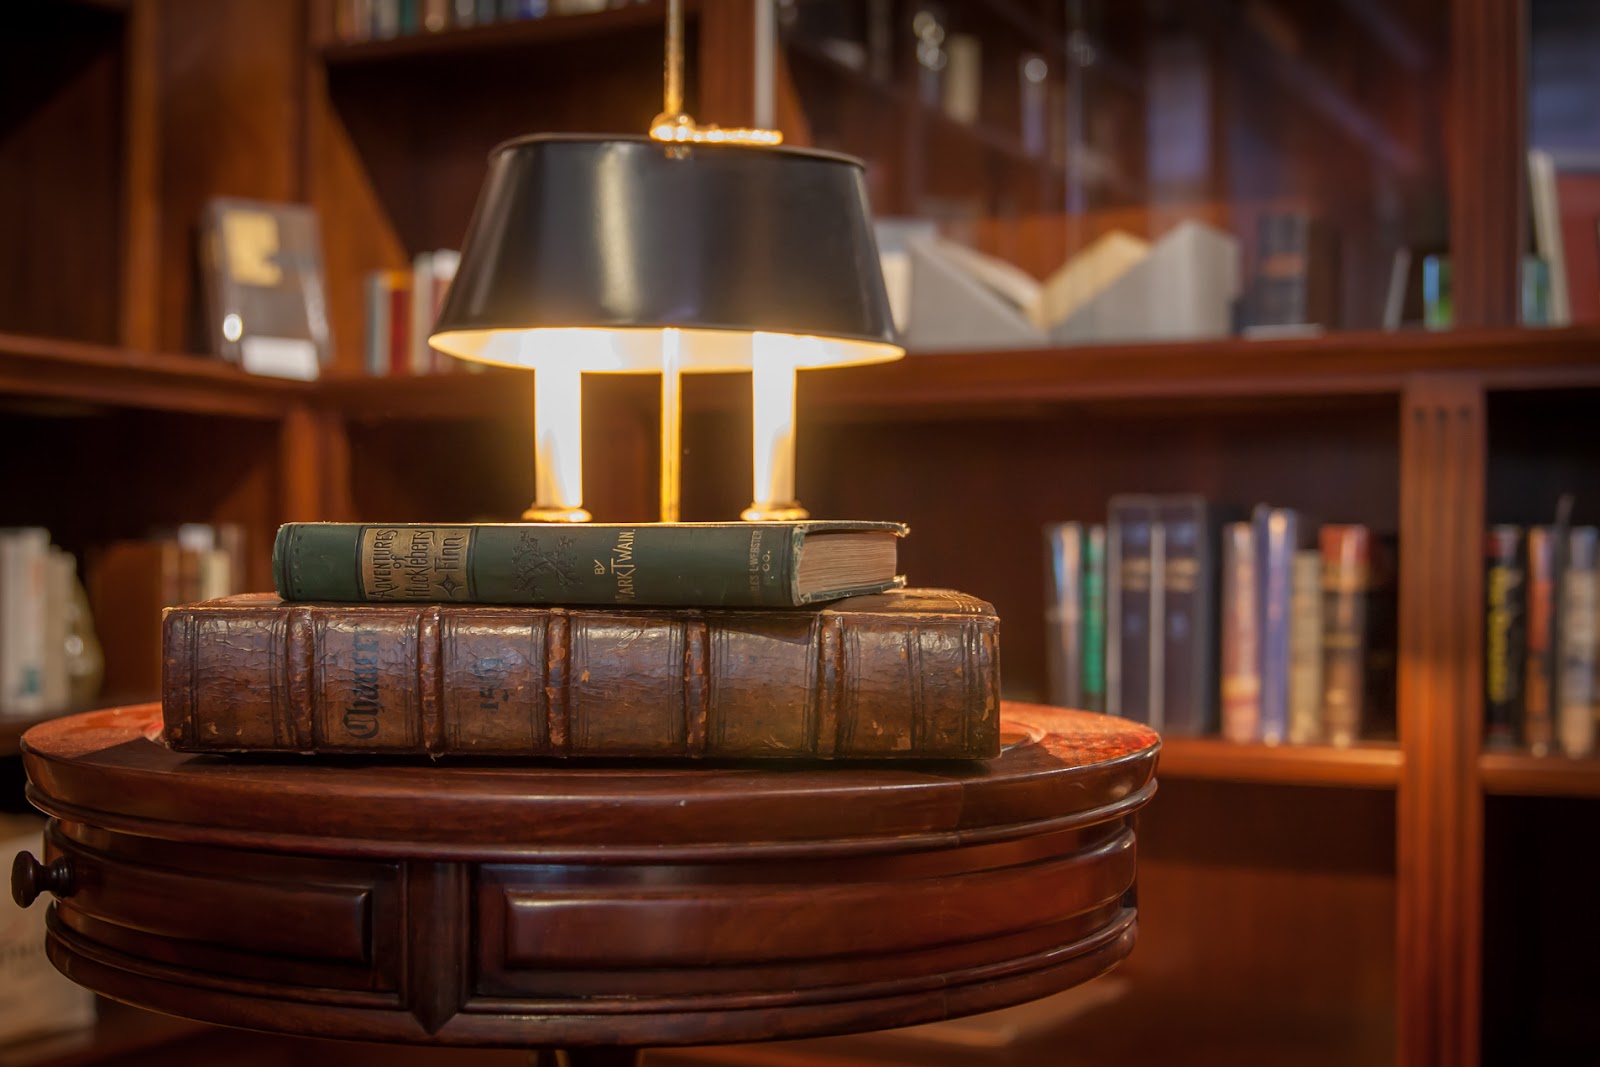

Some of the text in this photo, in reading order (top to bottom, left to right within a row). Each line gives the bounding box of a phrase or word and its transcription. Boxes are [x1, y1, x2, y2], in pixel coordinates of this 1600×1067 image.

[368, 529, 399, 598] ADVENTURES
[390, 554, 408, 569] of
[404, 530, 435, 598] Huckleberry
[594, 559, 605, 575] BY
